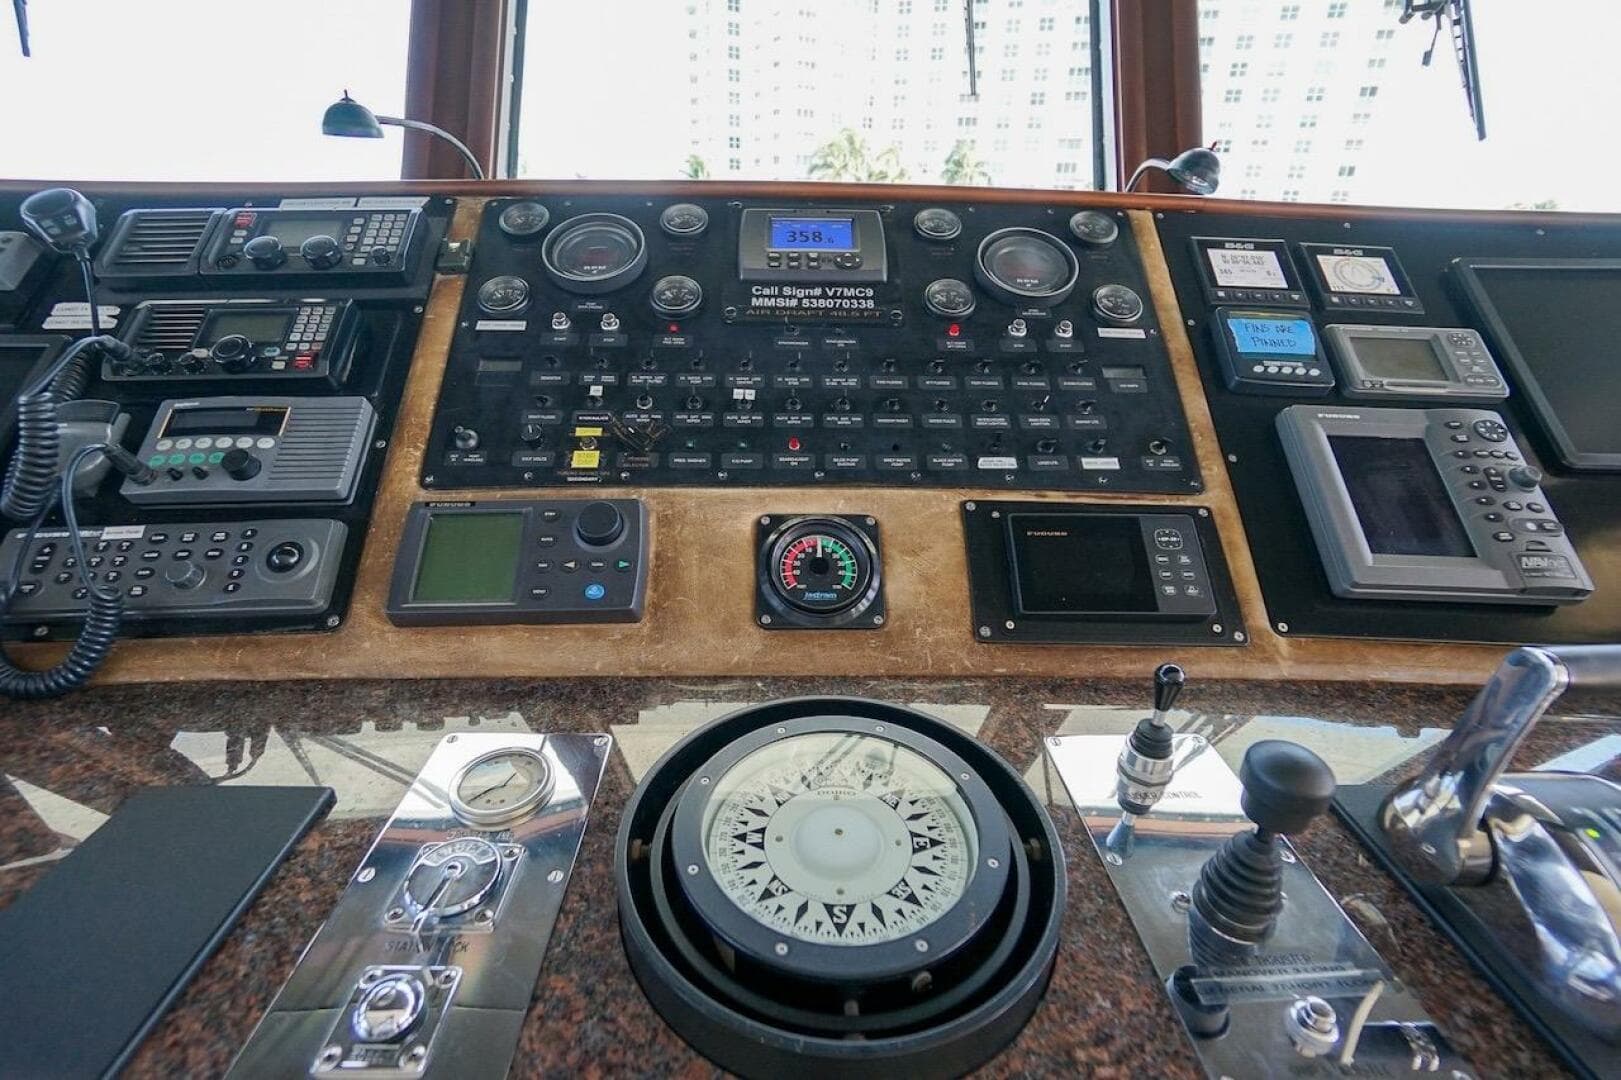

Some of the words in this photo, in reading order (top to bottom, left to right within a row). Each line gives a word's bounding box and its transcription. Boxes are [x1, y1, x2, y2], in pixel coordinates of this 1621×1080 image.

[751, 285, 779, 296] Call
[782, 286, 822, 298] Sign#
[825, 287, 874, 297] V7MC9
[751, 297, 799, 308] MMSI#
[801, 298, 875, 309] 538070338
[1244, 323, 1272, 334] FINS
[1250, 336, 1297, 348] PINNED
[833, 904, 848, 925] S
